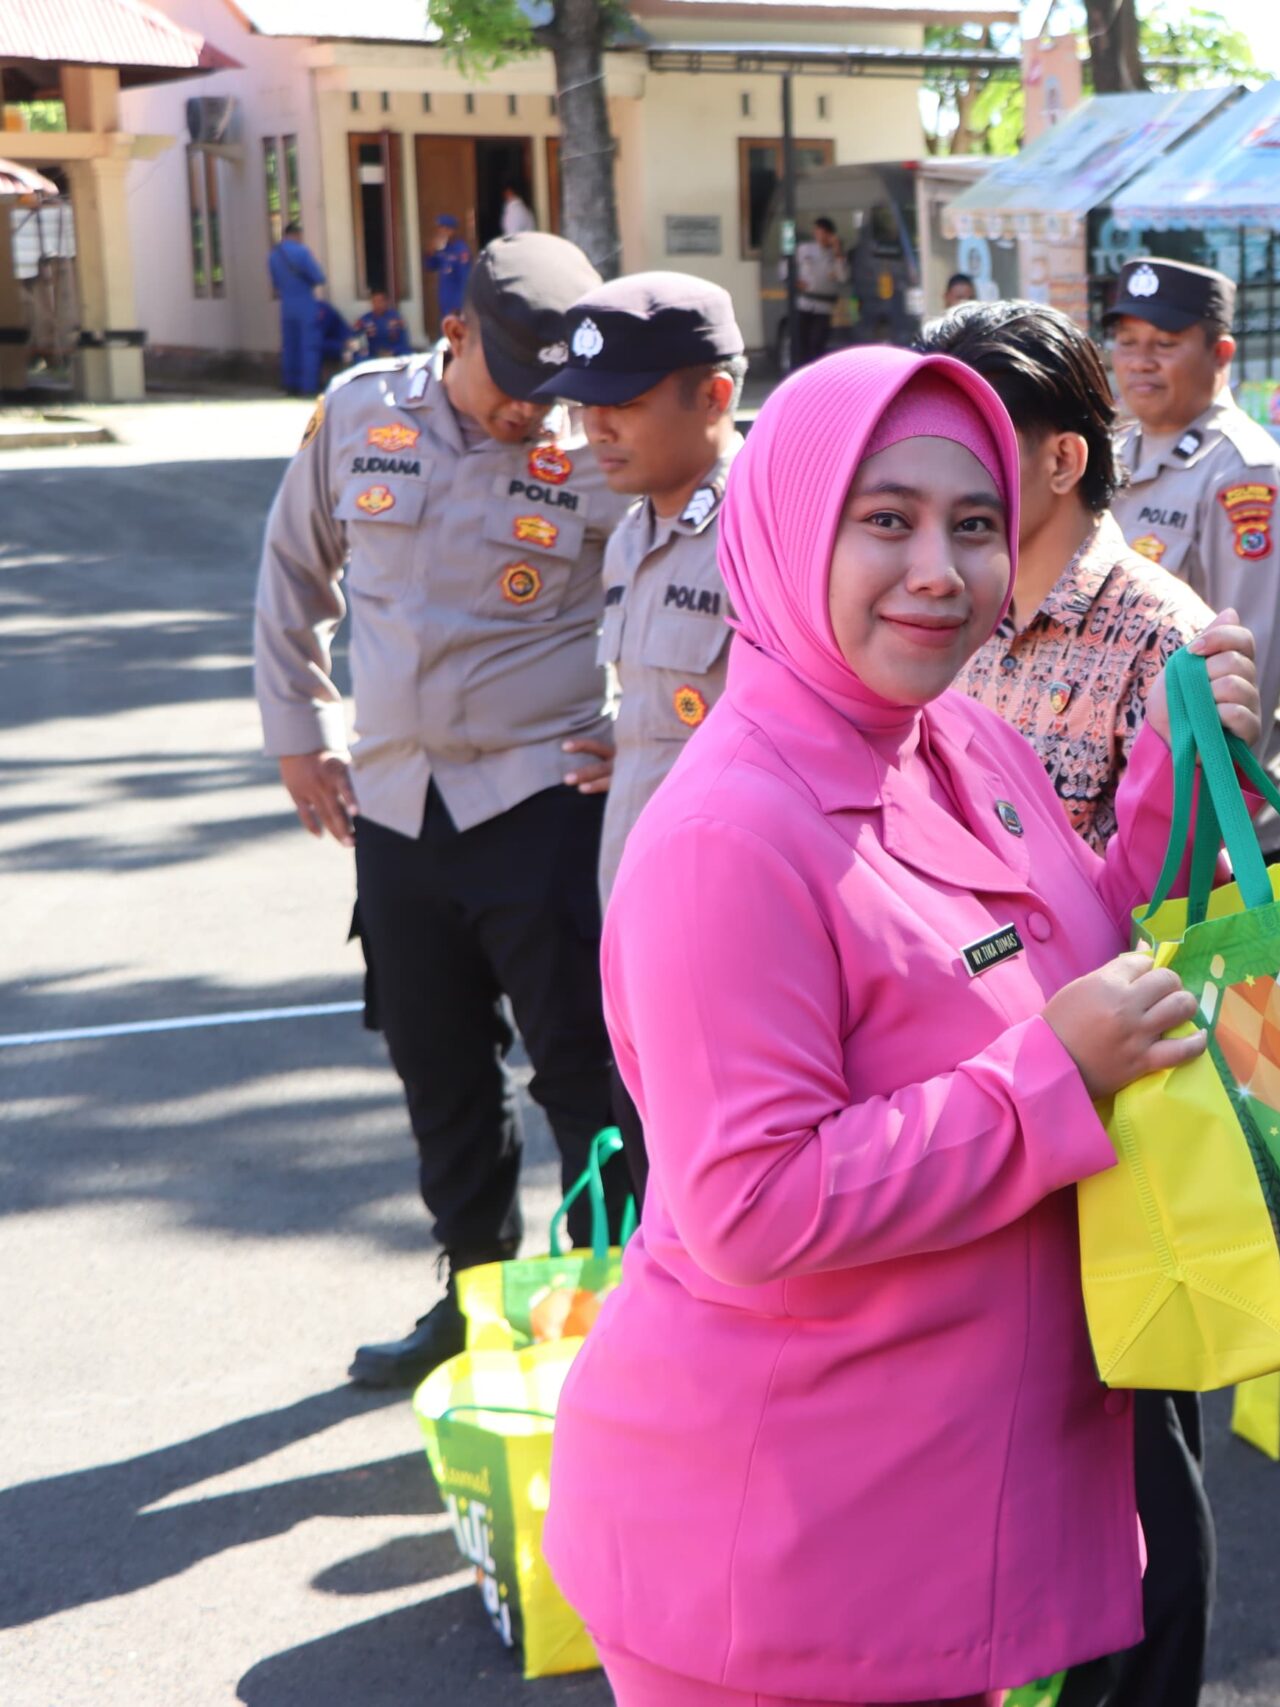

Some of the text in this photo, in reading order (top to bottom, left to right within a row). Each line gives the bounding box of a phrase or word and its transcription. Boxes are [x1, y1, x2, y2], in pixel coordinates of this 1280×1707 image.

[351, 456, 421, 477] SUDIANA
[508, 479, 579, 511] POLRI
[1138, 506, 1188, 529] POLRI
[663, 584, 721, 616] POLRI
